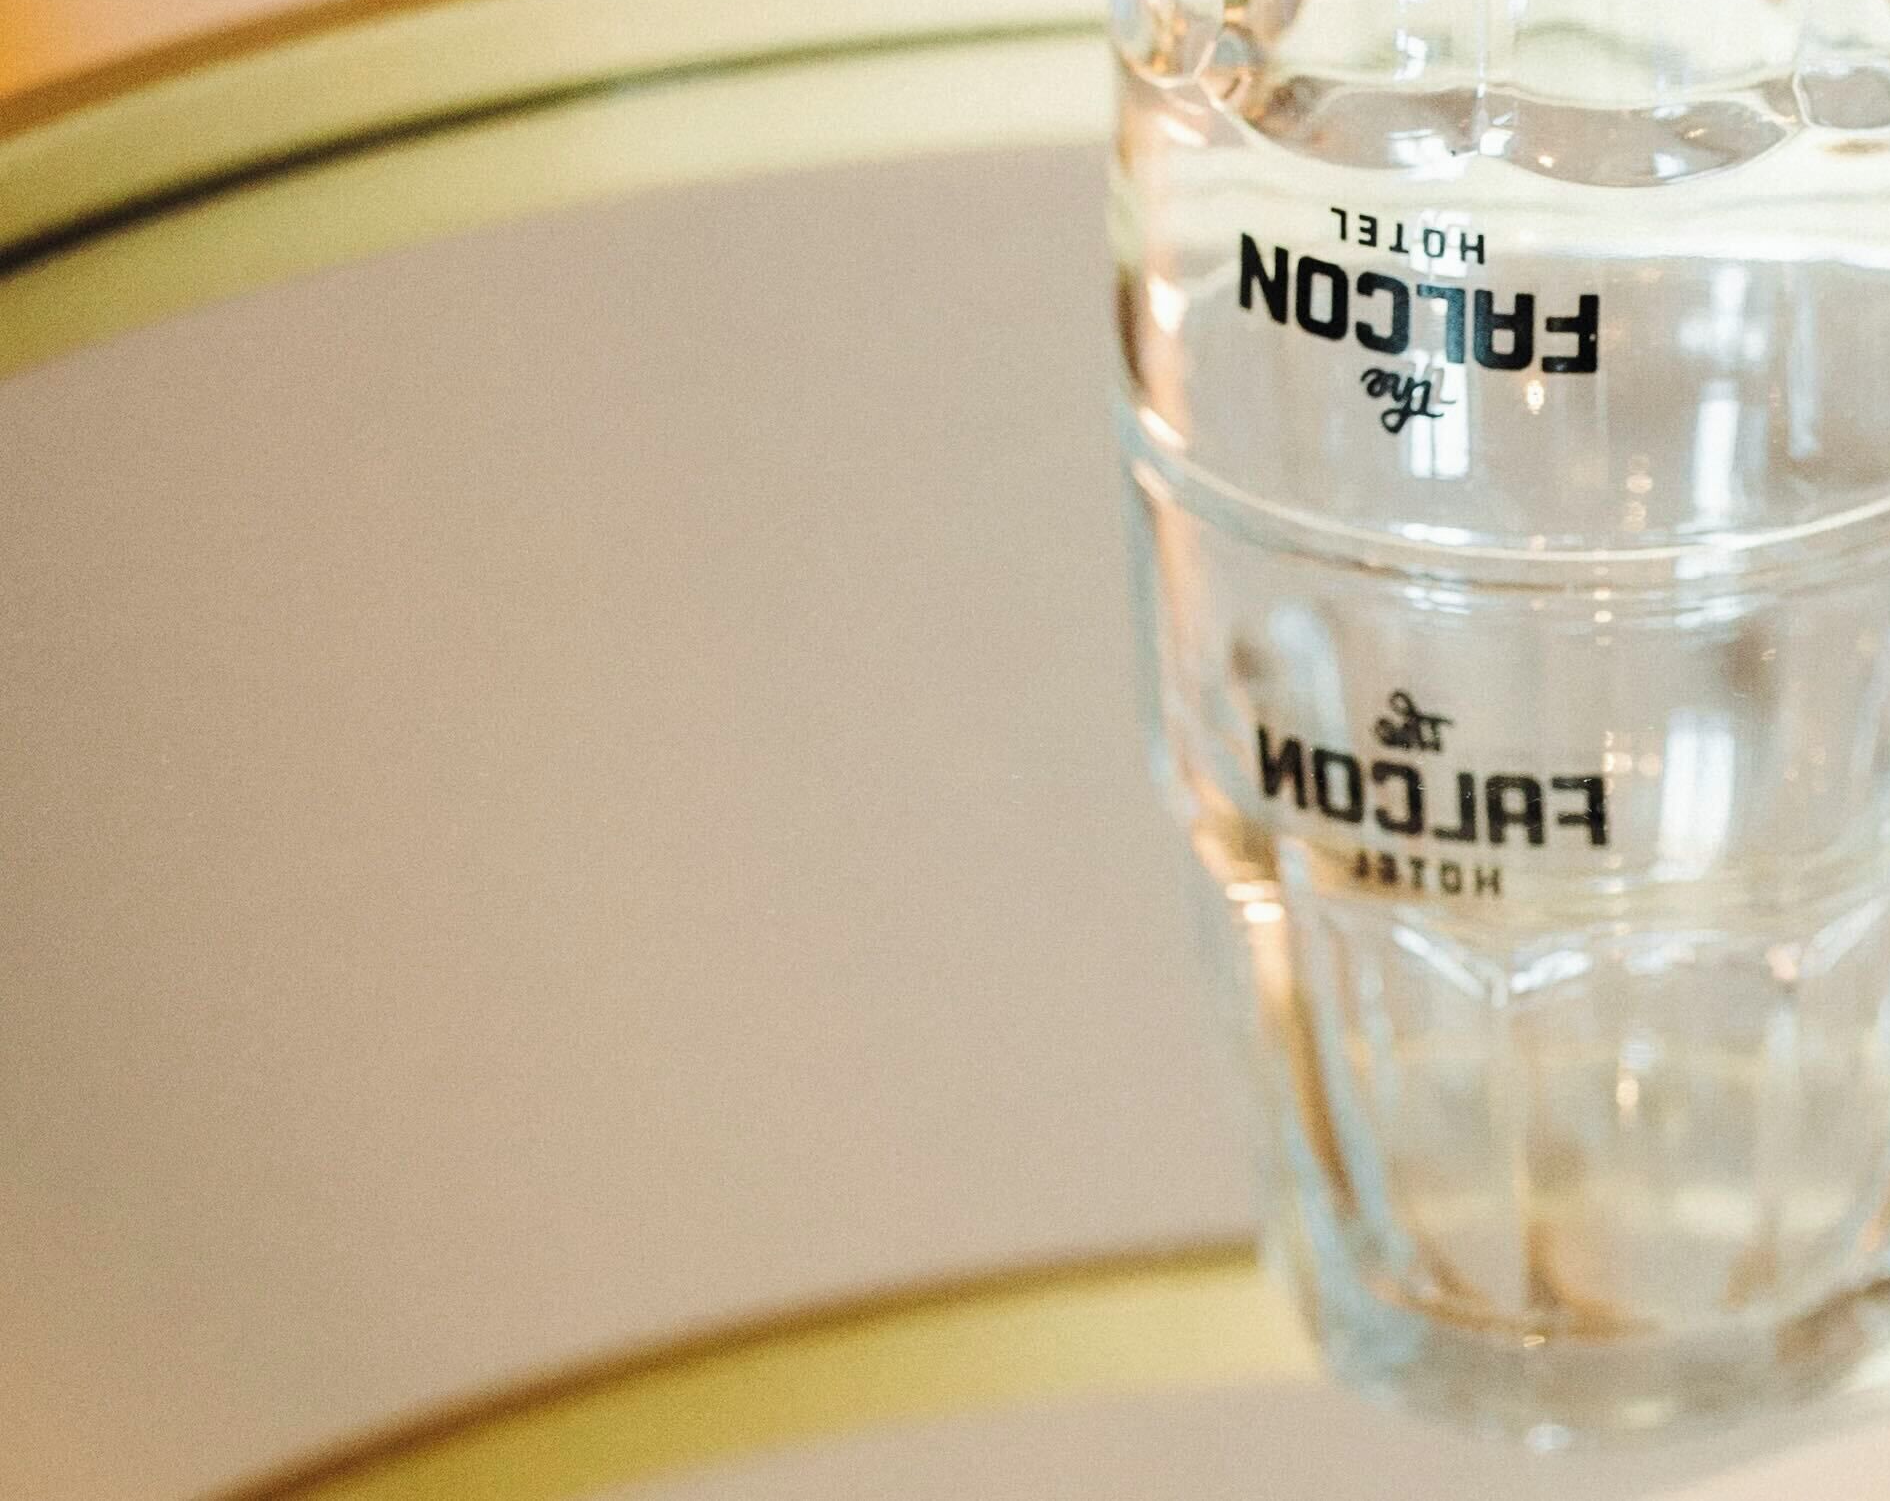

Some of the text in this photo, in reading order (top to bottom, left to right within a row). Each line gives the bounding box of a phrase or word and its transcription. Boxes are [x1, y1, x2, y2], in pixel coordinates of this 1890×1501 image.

[1330, 207, 1485, 264] HOTEL
[1239, 232, 1600, 374] FALCON
[1360, 367, 1456, 433] the
